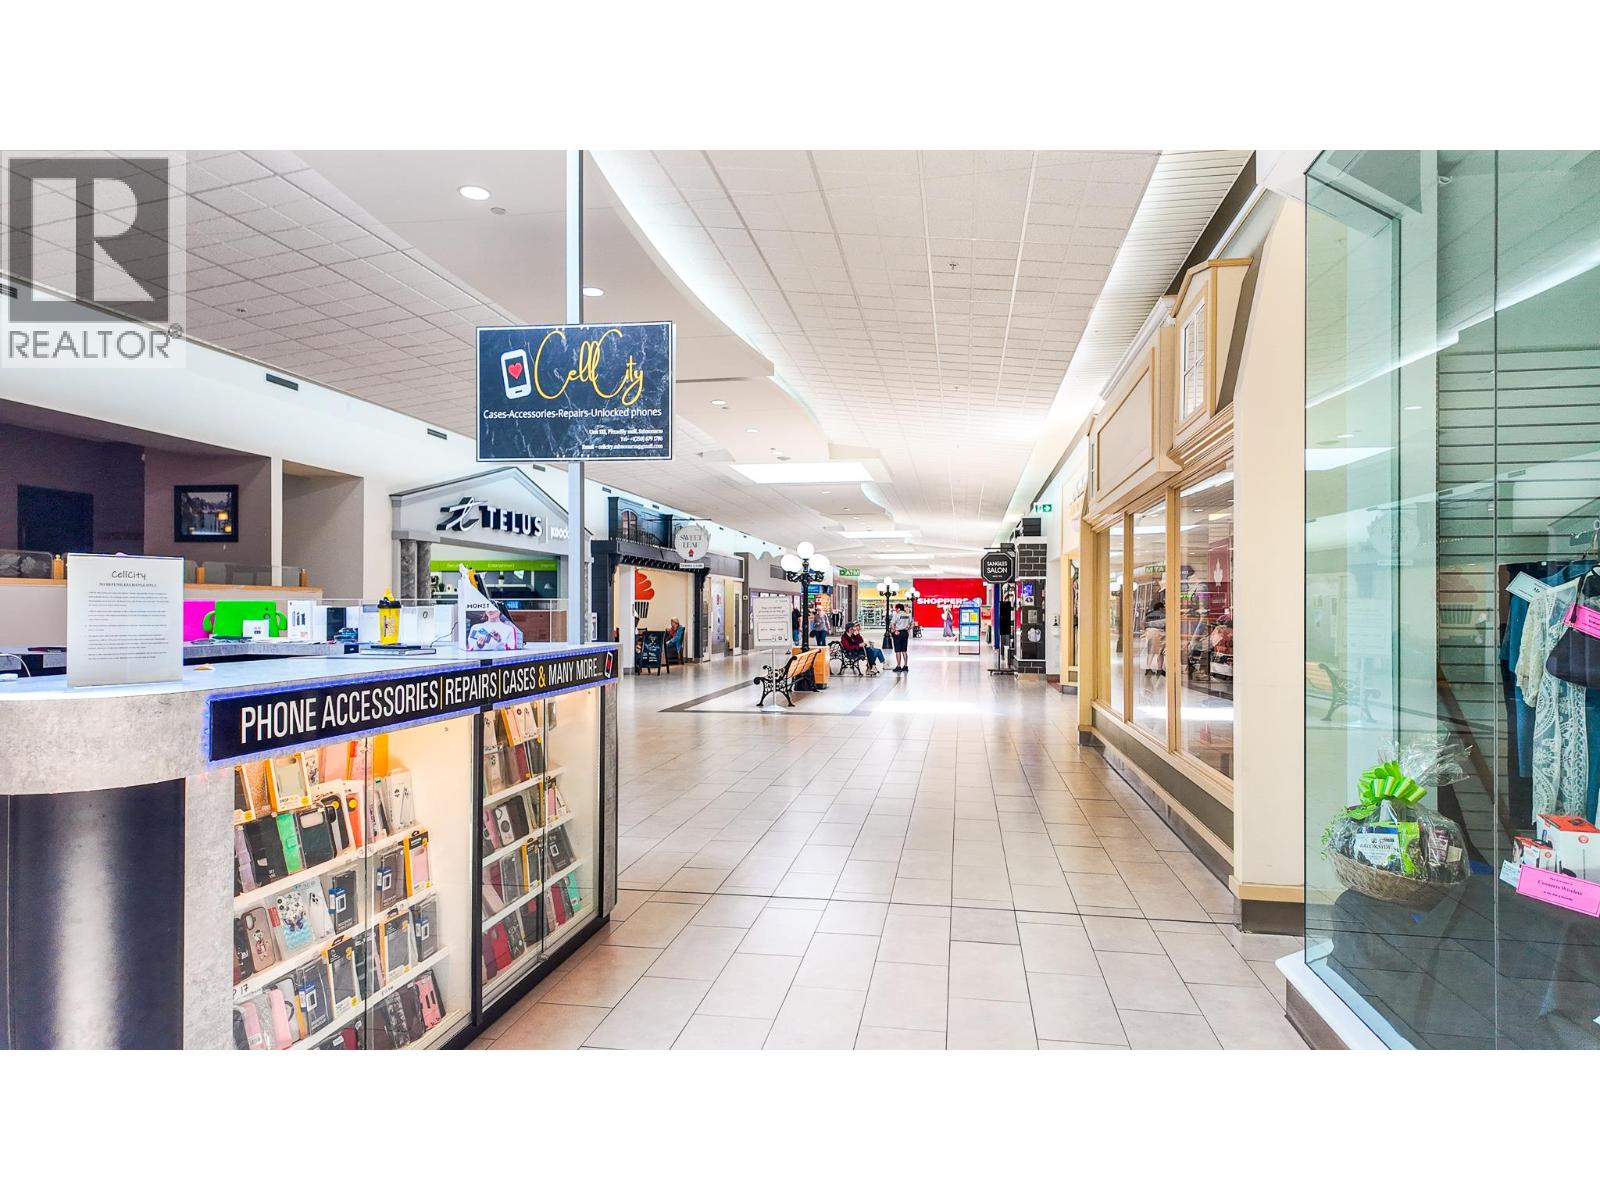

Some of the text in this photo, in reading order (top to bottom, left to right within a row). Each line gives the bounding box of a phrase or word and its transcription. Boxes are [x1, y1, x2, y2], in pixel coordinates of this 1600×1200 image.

[631, 407, 662, 418] phones
[483, 506, 543, 537] TELUS
[111, 570, 147, 580] CellCity
[241, 697, 317, 744] PHONE
[538, 664, 547, 688] &
[548, 662, 574, 686] MANY
